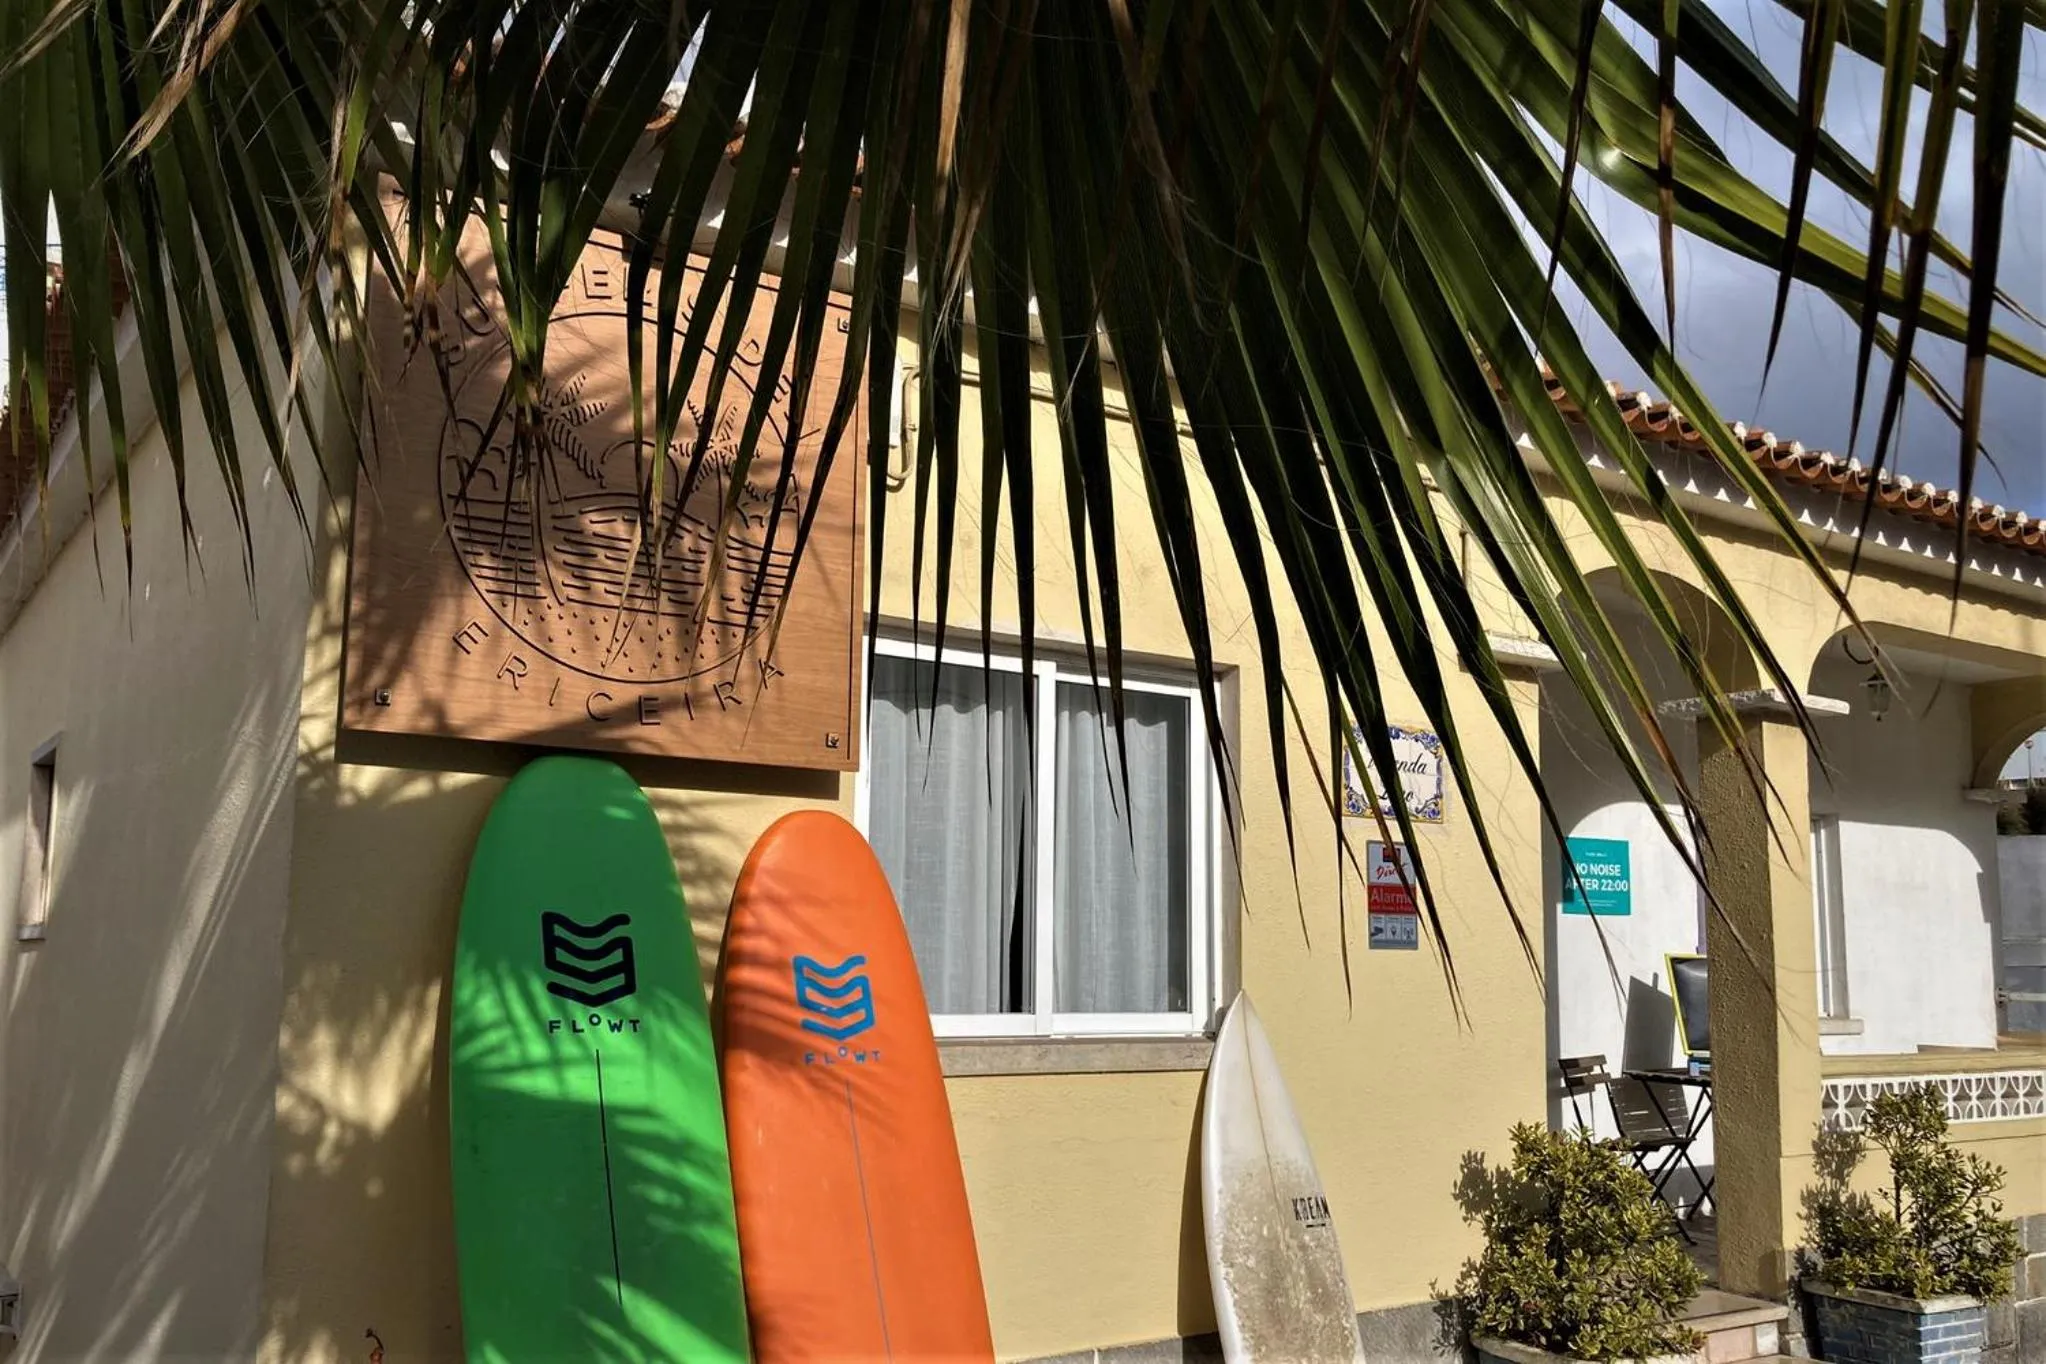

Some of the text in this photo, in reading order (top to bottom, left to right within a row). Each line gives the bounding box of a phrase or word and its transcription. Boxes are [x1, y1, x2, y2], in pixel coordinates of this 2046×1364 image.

[453, 621, 785, 726] ERICEIRA
[1589, 864, 1622, 877] NOISE
[548, 1013, 641, 1034] FLOWT
[804, 1045, 881, 1066] FLOWT
